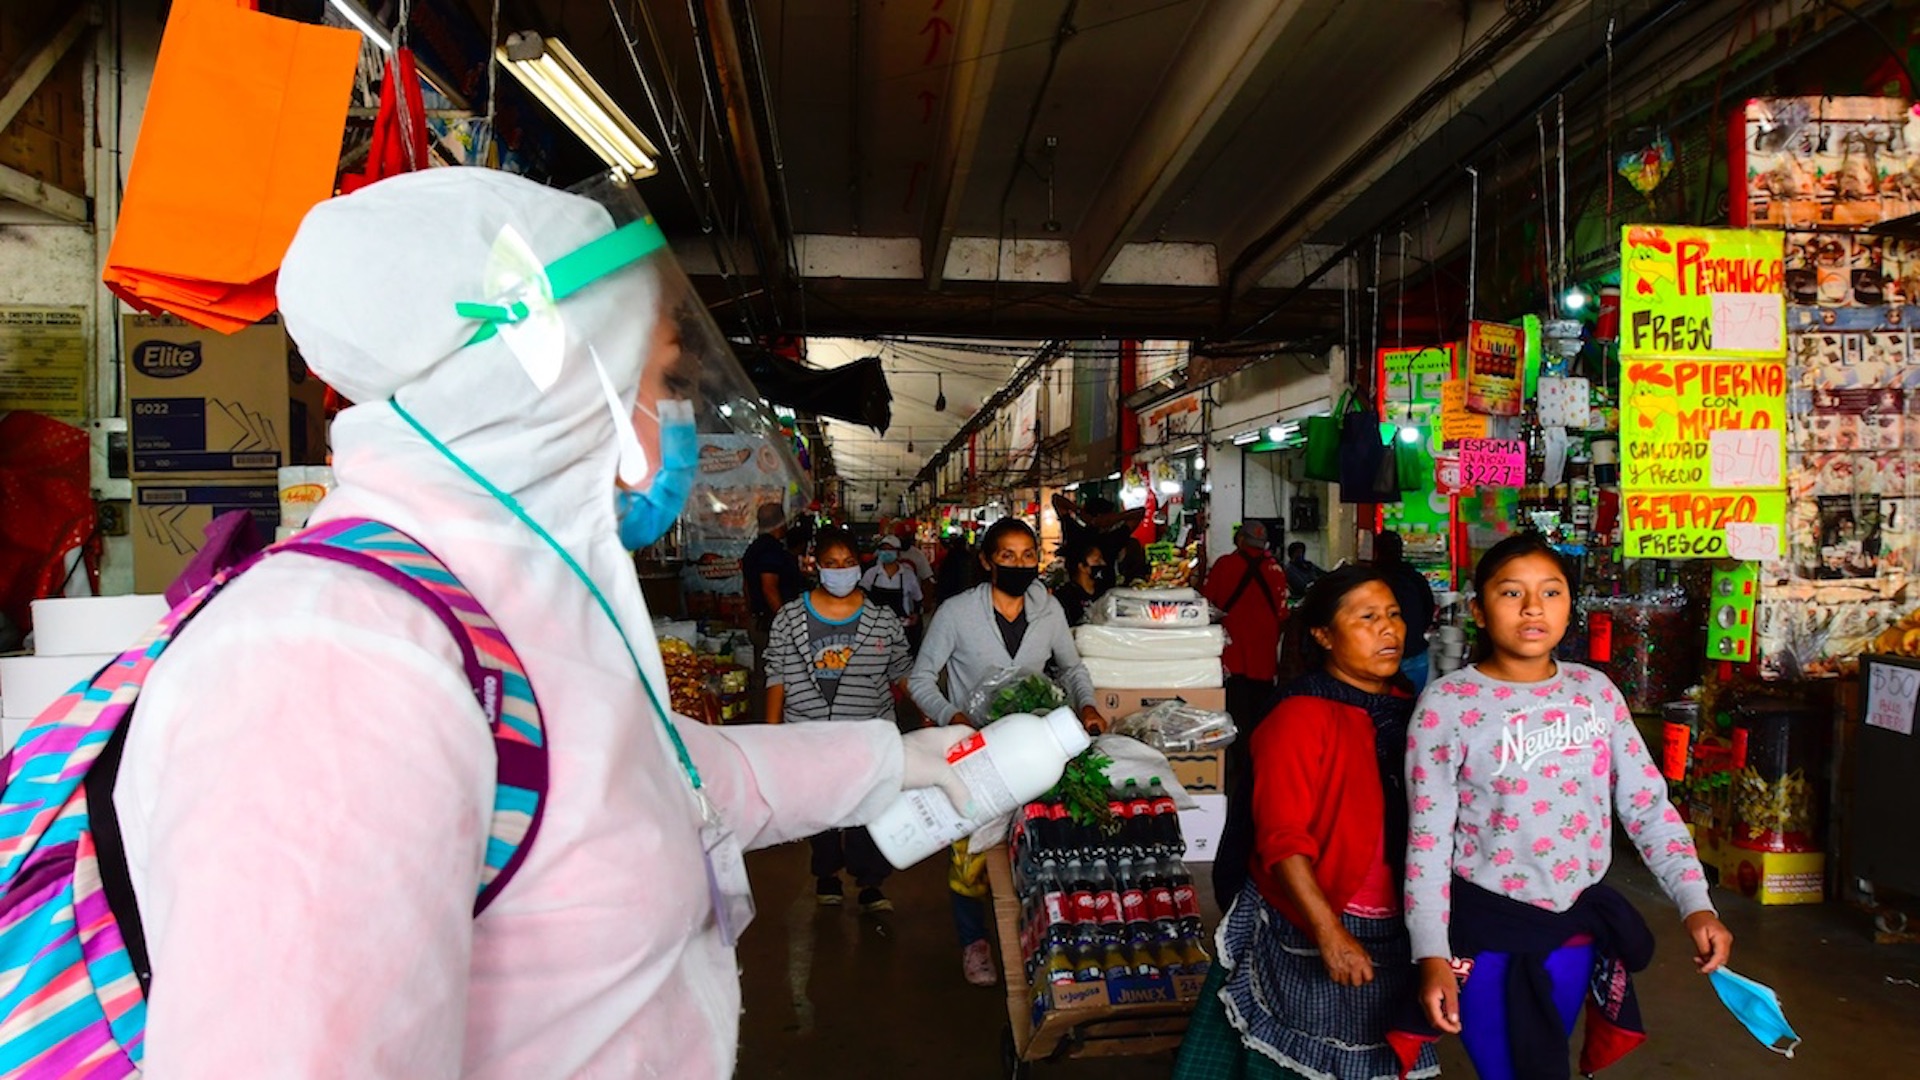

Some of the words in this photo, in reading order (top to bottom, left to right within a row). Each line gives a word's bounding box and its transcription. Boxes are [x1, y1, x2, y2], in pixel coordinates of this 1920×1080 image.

[1676, 238, 1784, 296] PECHUGA
[1632, 310, 1713, 350] FRESC
[1714, 301, 1780, 343] $75
[143, 345, 196, 368] Elite
[1674, 362, 1784, 398] PIERNA
[135, 403, 170, 415] 6022
[1702, 396, 1739, 408] CON
[1464, 440, 1521, 454] ESPUMA
[1629, 441, 1709, 459] CALIDAD
[1713, 436, 1776, 480] $40
[1463, 463, 1511, 485] $227
[1649, 463, 1703, 484] PRECIO
[1626, 491, 1758, 531] RETAZO
[1638, 533, 1723, 556] FRESCO
[1872, 665, 1916, 699] $50
[1491, 717, 1557, 776] New
[1553, 702, 1607, 752] York
[1117, 986, 1168, 1004] JUMEX
